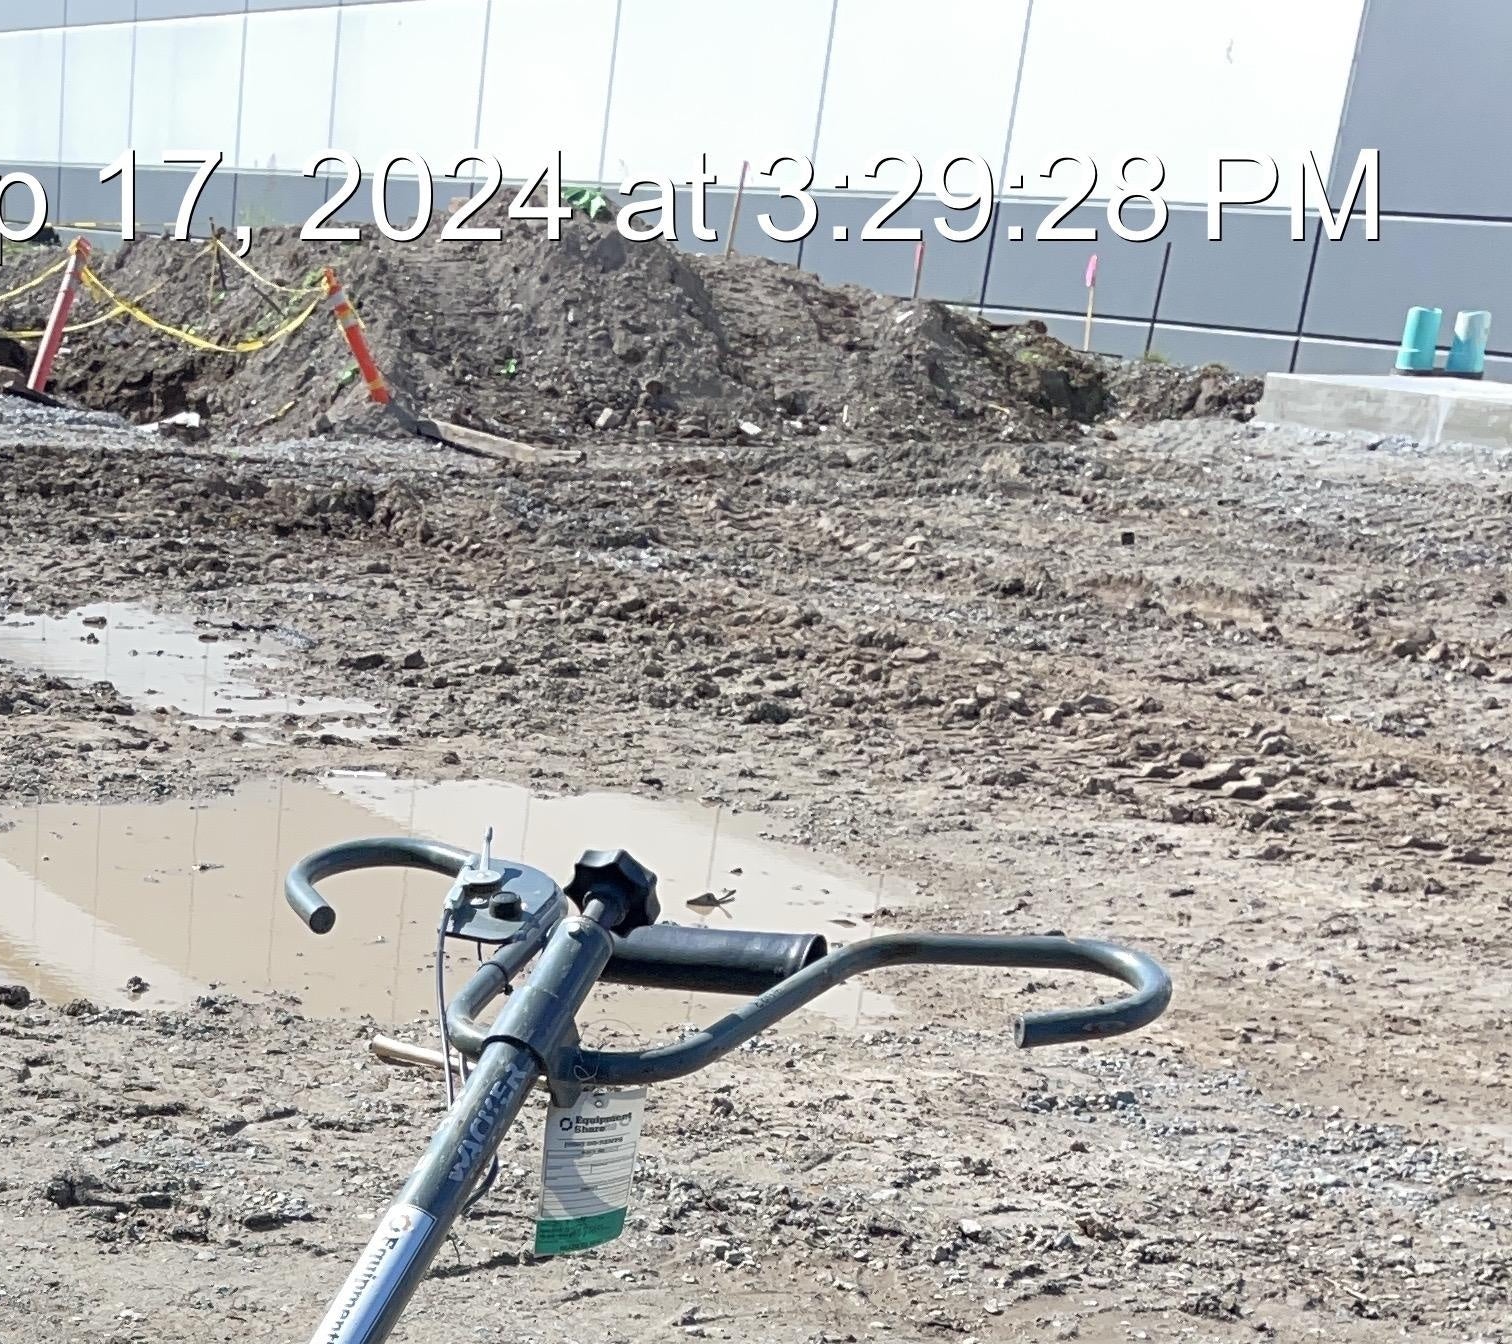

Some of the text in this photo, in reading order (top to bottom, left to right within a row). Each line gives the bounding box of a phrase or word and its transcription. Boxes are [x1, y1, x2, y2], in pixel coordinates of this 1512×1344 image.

[448, 1063, 527, 1182] WACKER
[575, 1112, 632, 1126] Equipment
[574, 1125, 606, 1134] Share
